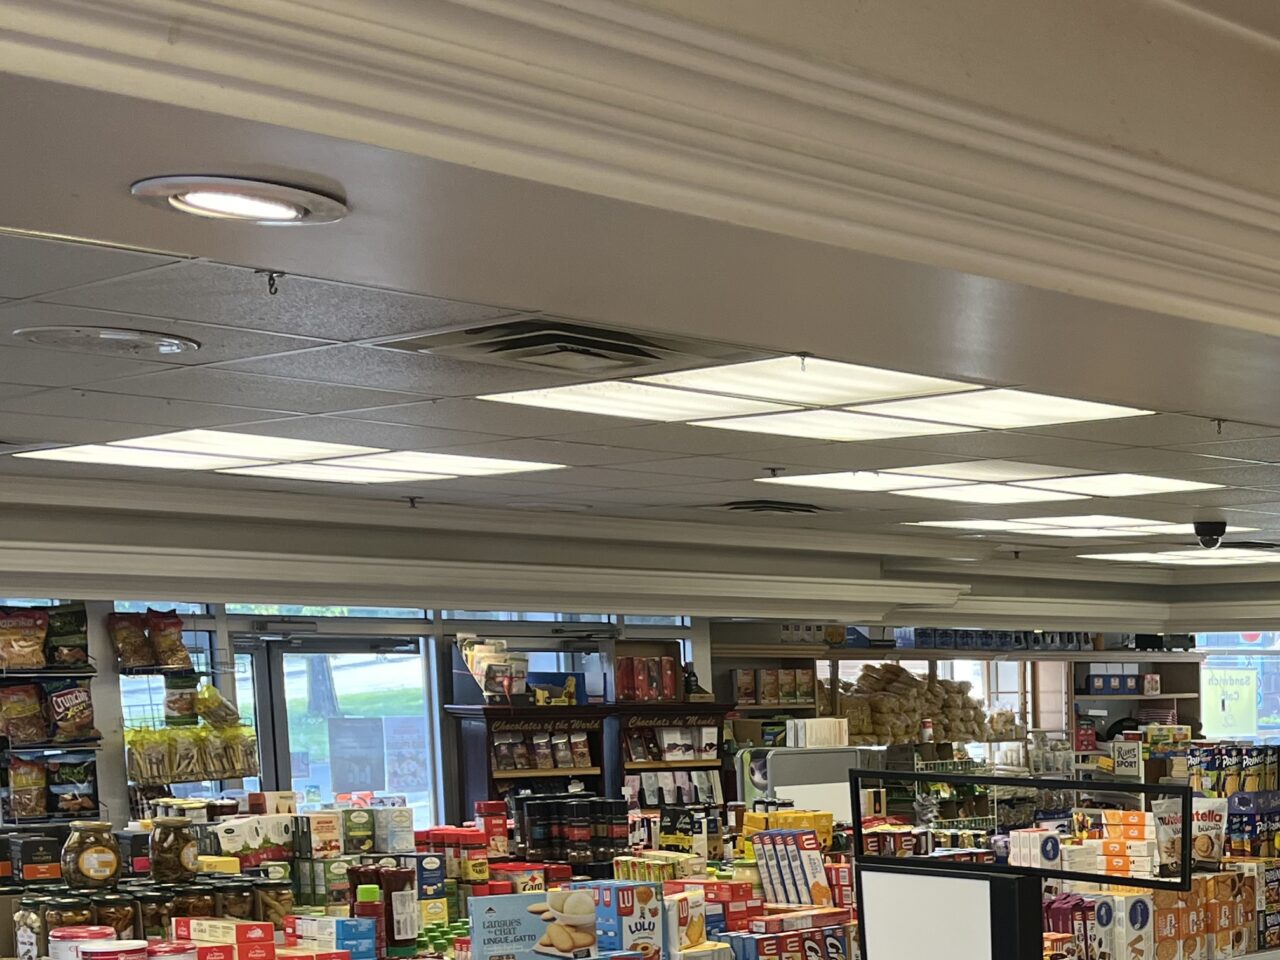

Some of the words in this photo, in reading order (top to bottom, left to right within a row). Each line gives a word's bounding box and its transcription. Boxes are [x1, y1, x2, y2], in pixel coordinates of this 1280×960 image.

[491, 720, 542, 731] Chocolates
[544, 719, 555, 731] of
[556, 719, 569, 729] the
[571, 718, 600, 729] World
[628, 716, 669, 727] Chocolats
[670, 716, 684, 726] du
[685, 716, 716, 726] Monde
[802, 834, 817, 849] LU
[619, 890, 632, 907] LU
[679, 899, 688, 918] LU
[628, 921, 656, 934] LULU
[483, 936, 509, 945] LINGUE
[514, 934, 536, 942] GATTO
[787, 938, 799, 951] LU
[763, 940, 776, 954] LU
